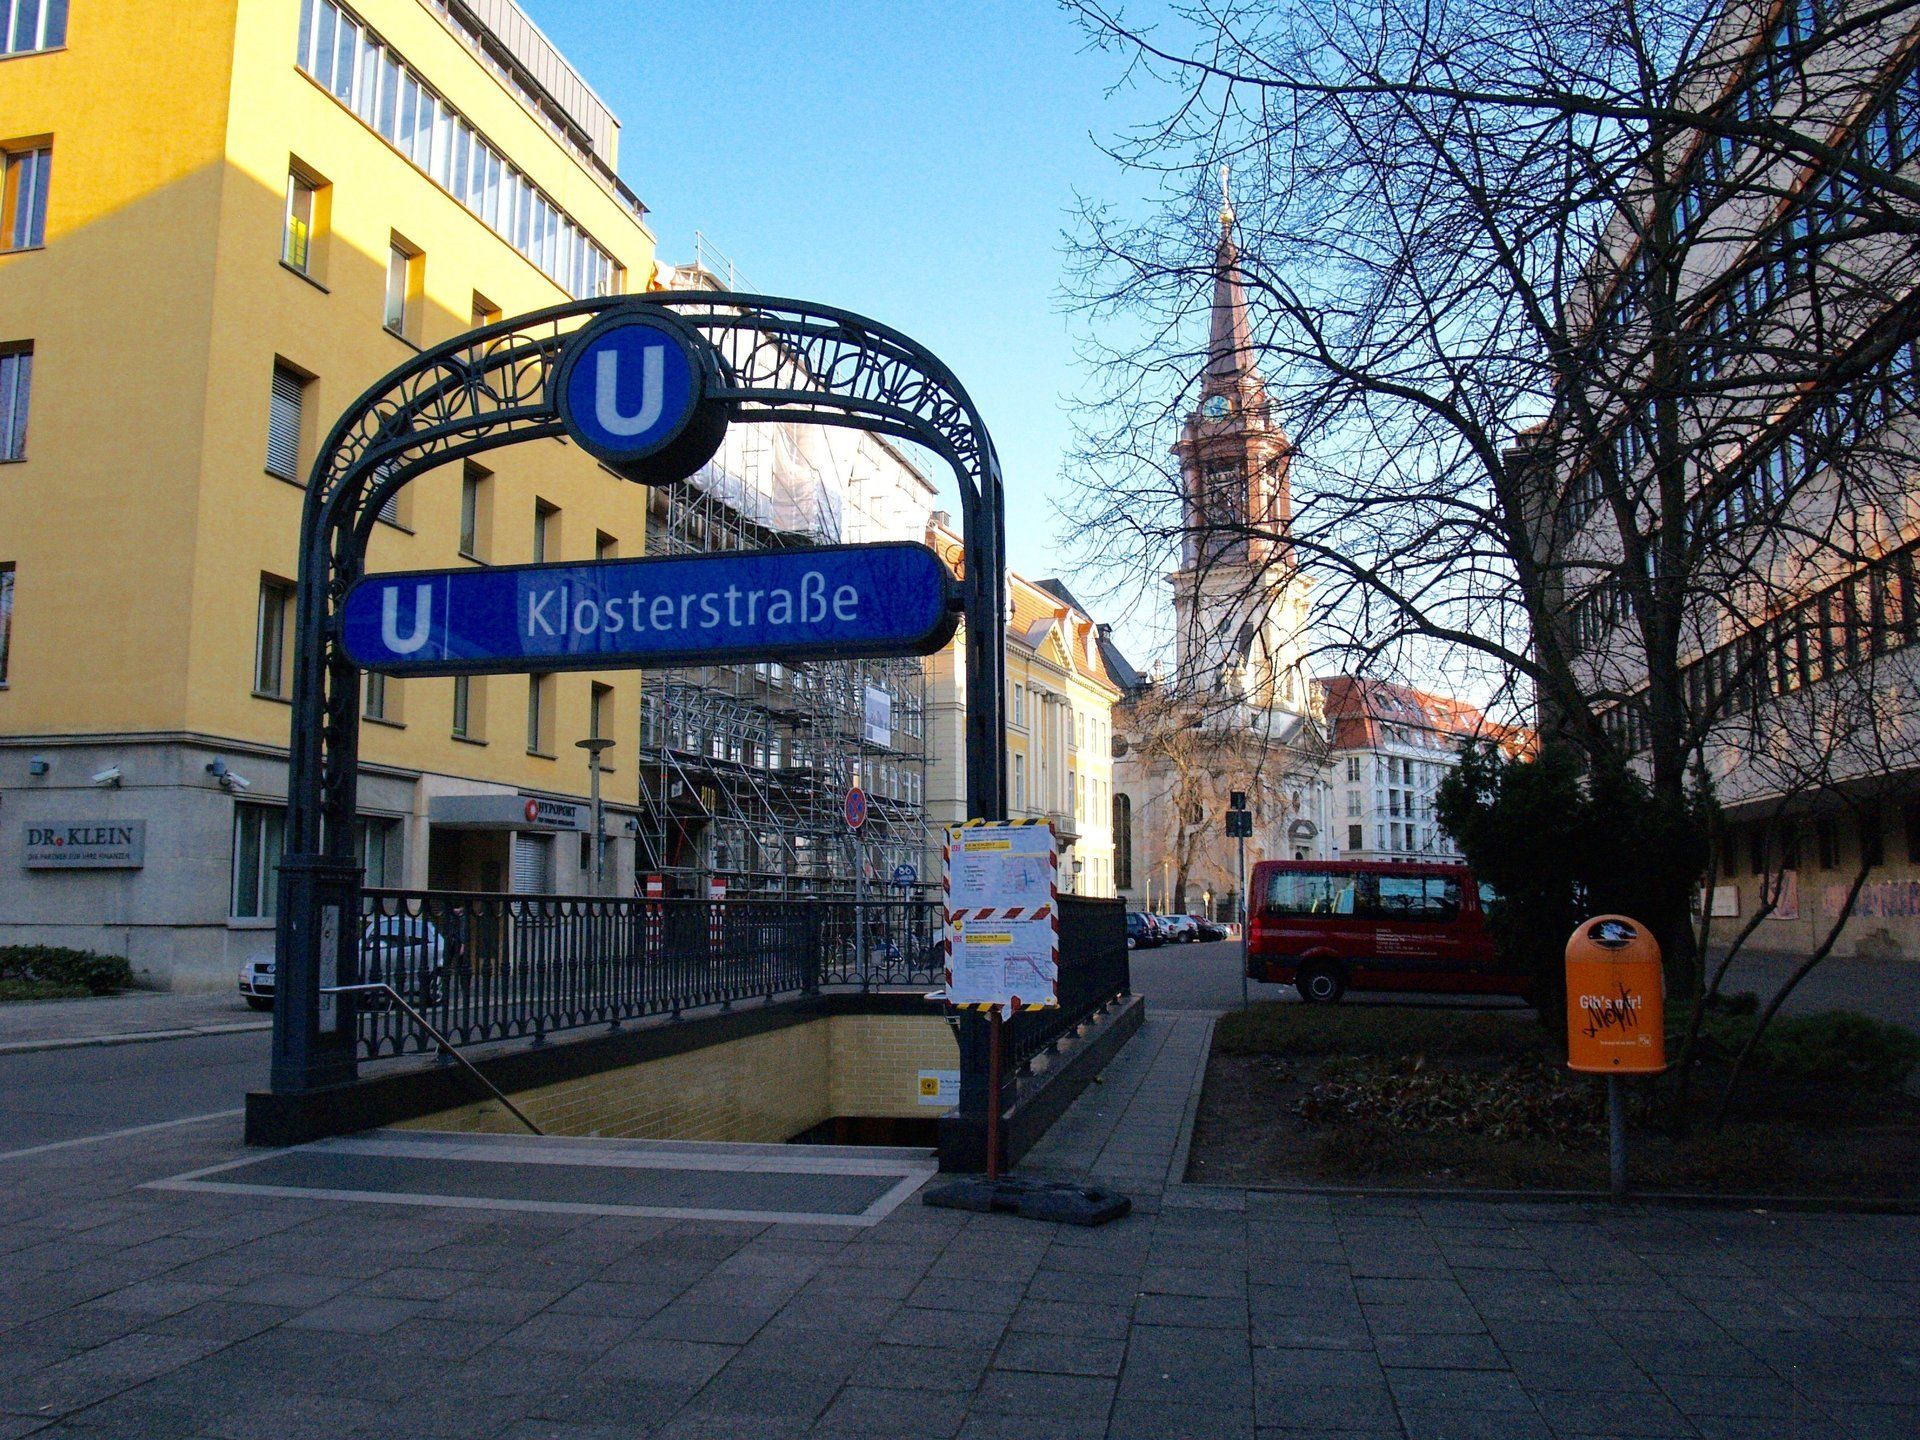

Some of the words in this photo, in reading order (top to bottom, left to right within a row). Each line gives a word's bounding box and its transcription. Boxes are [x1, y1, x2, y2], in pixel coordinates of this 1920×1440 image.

[594, 345, 664, 436] U
[381, 585, 432, 653] U
[527, 571, 859, 637] Klosterstraße
[66, 827, 133, 846] KLEIN
